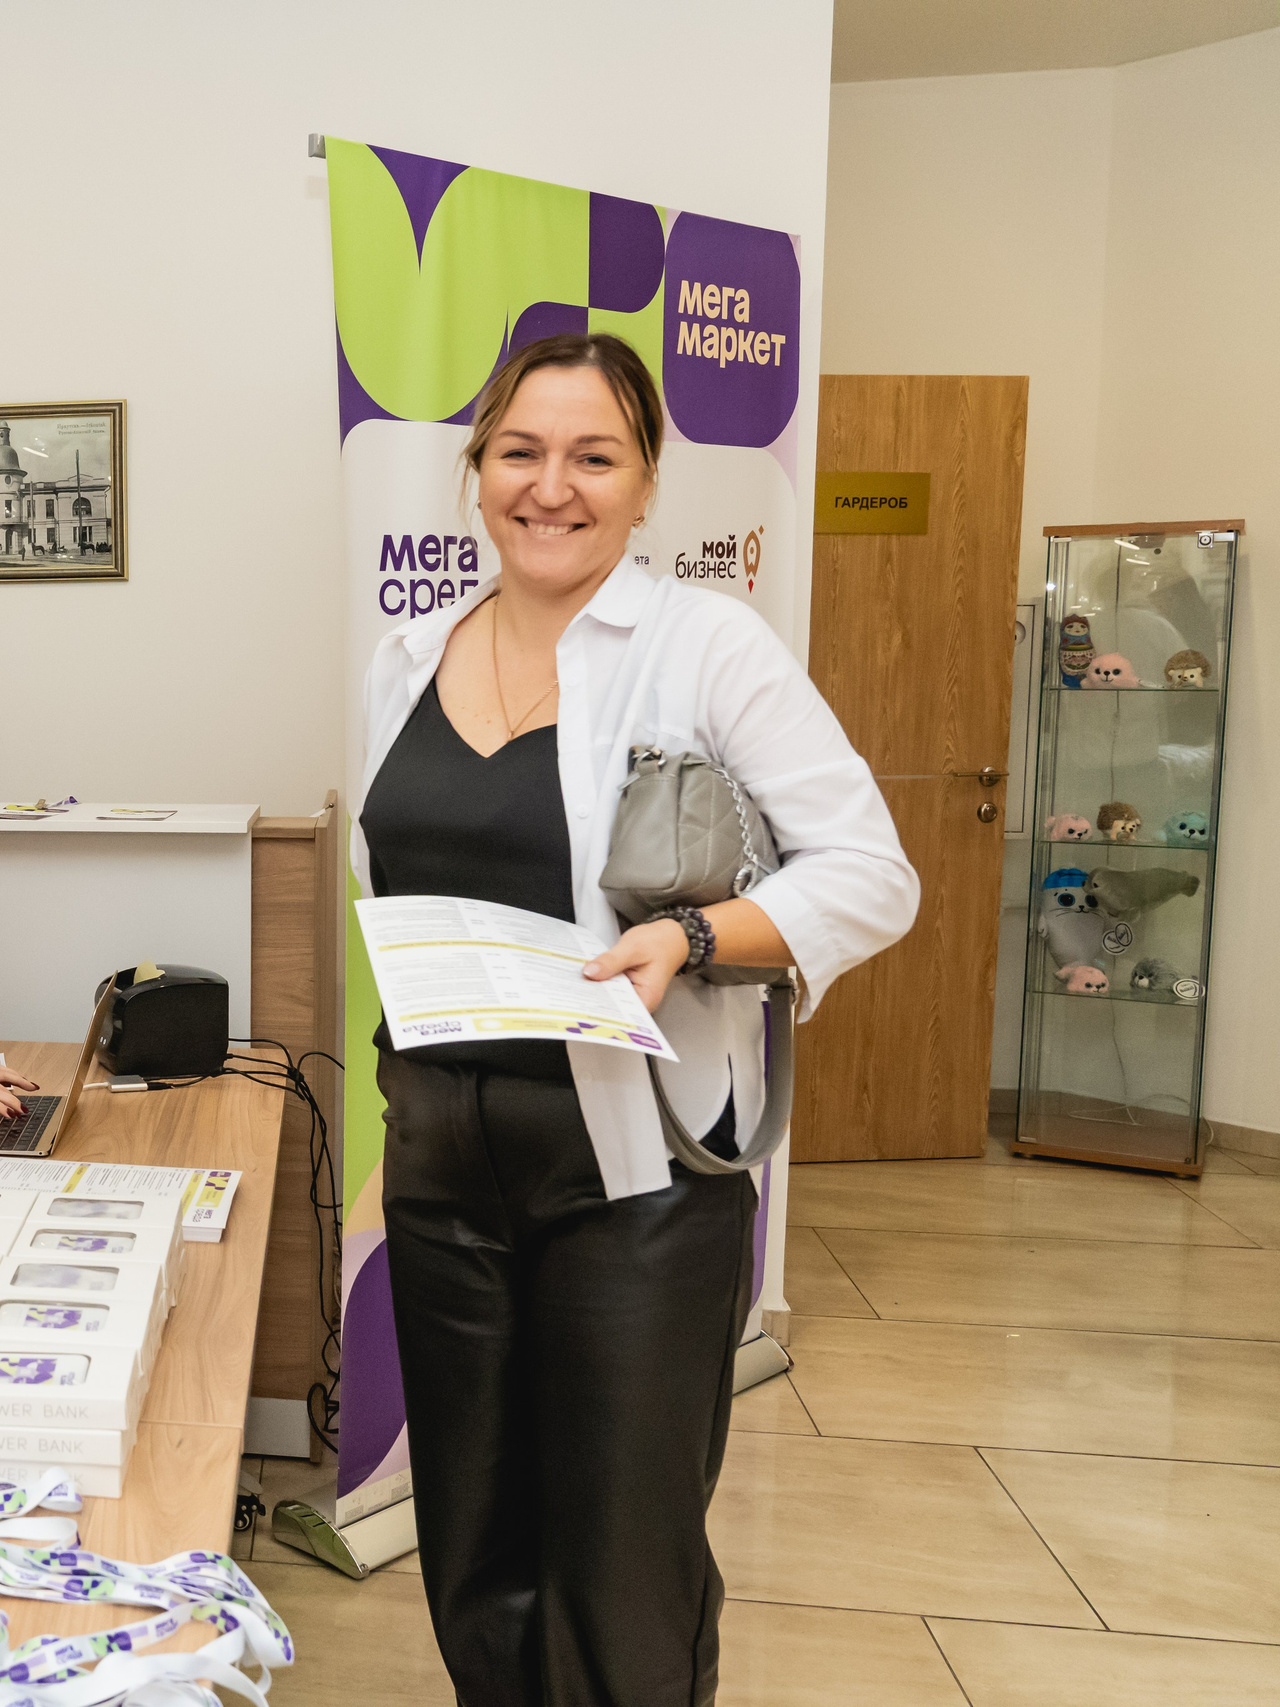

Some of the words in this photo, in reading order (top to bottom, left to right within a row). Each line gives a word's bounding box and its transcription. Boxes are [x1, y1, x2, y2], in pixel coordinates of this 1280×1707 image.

[678, 280, 750, 323] мега
[677, 321, 786, 369] маркет
[834, 497, 908, 511] ГАРДЕРОБ
[379, 534, 478, 572] мега
[702, 534, 737, 559] мой
[675, 552, 737, 579] бизнес
[43, 1405, 89, 1419] BANK
[38, 1438, 83, 1454] BANK
